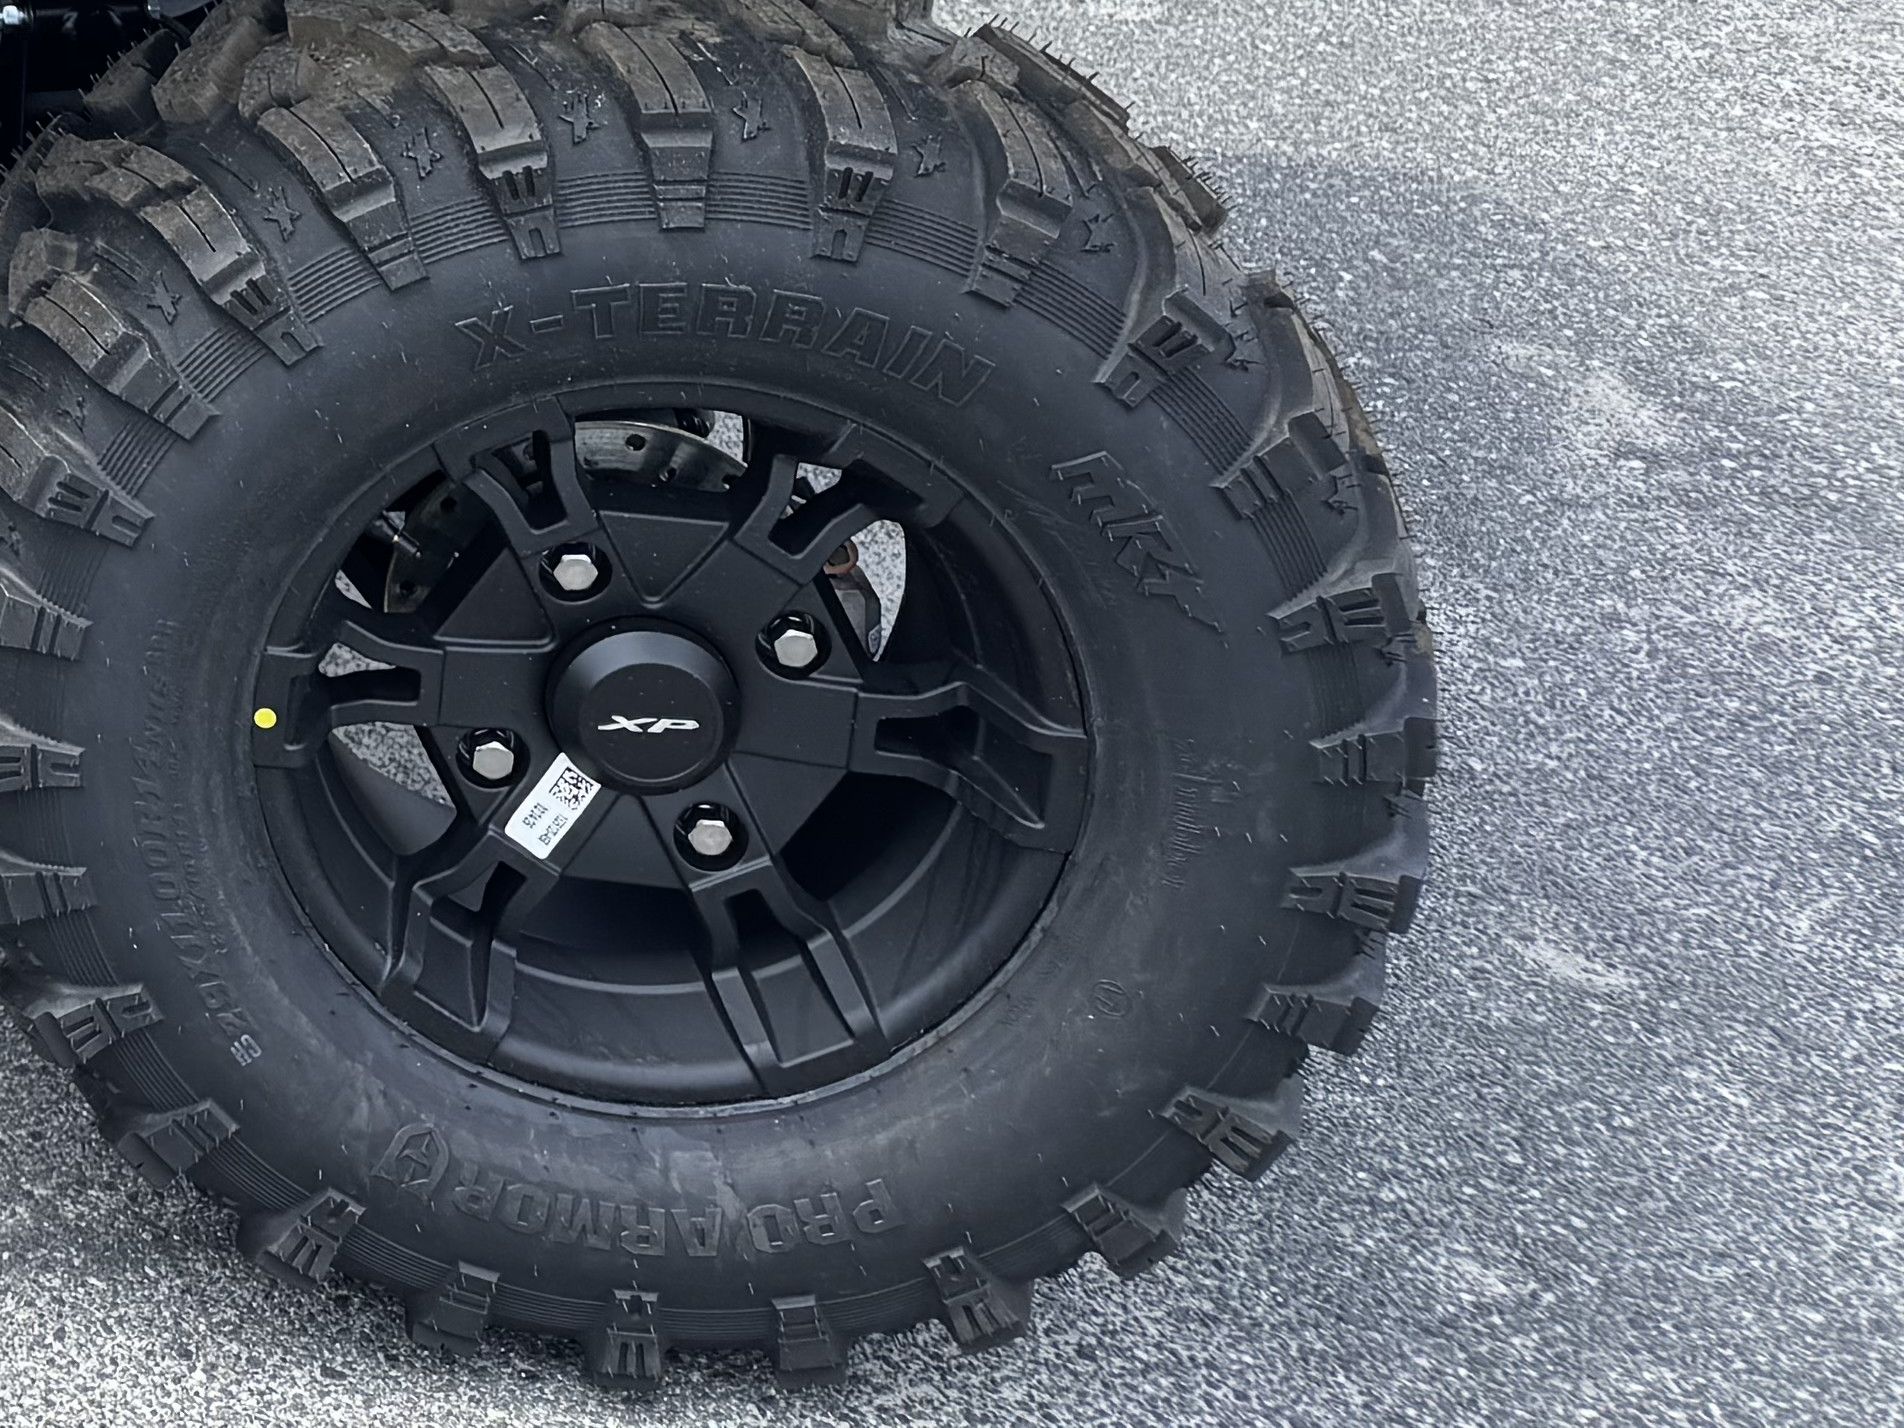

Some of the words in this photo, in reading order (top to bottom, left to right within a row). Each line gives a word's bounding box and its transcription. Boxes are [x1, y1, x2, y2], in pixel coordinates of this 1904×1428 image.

[453, 281, 996, 408] X-TERRAIN
[597, 714, 700, 734] XP
[450, 1158, 723, 1259] ARMOR
[744, 1178, 904, 1256] PRO
